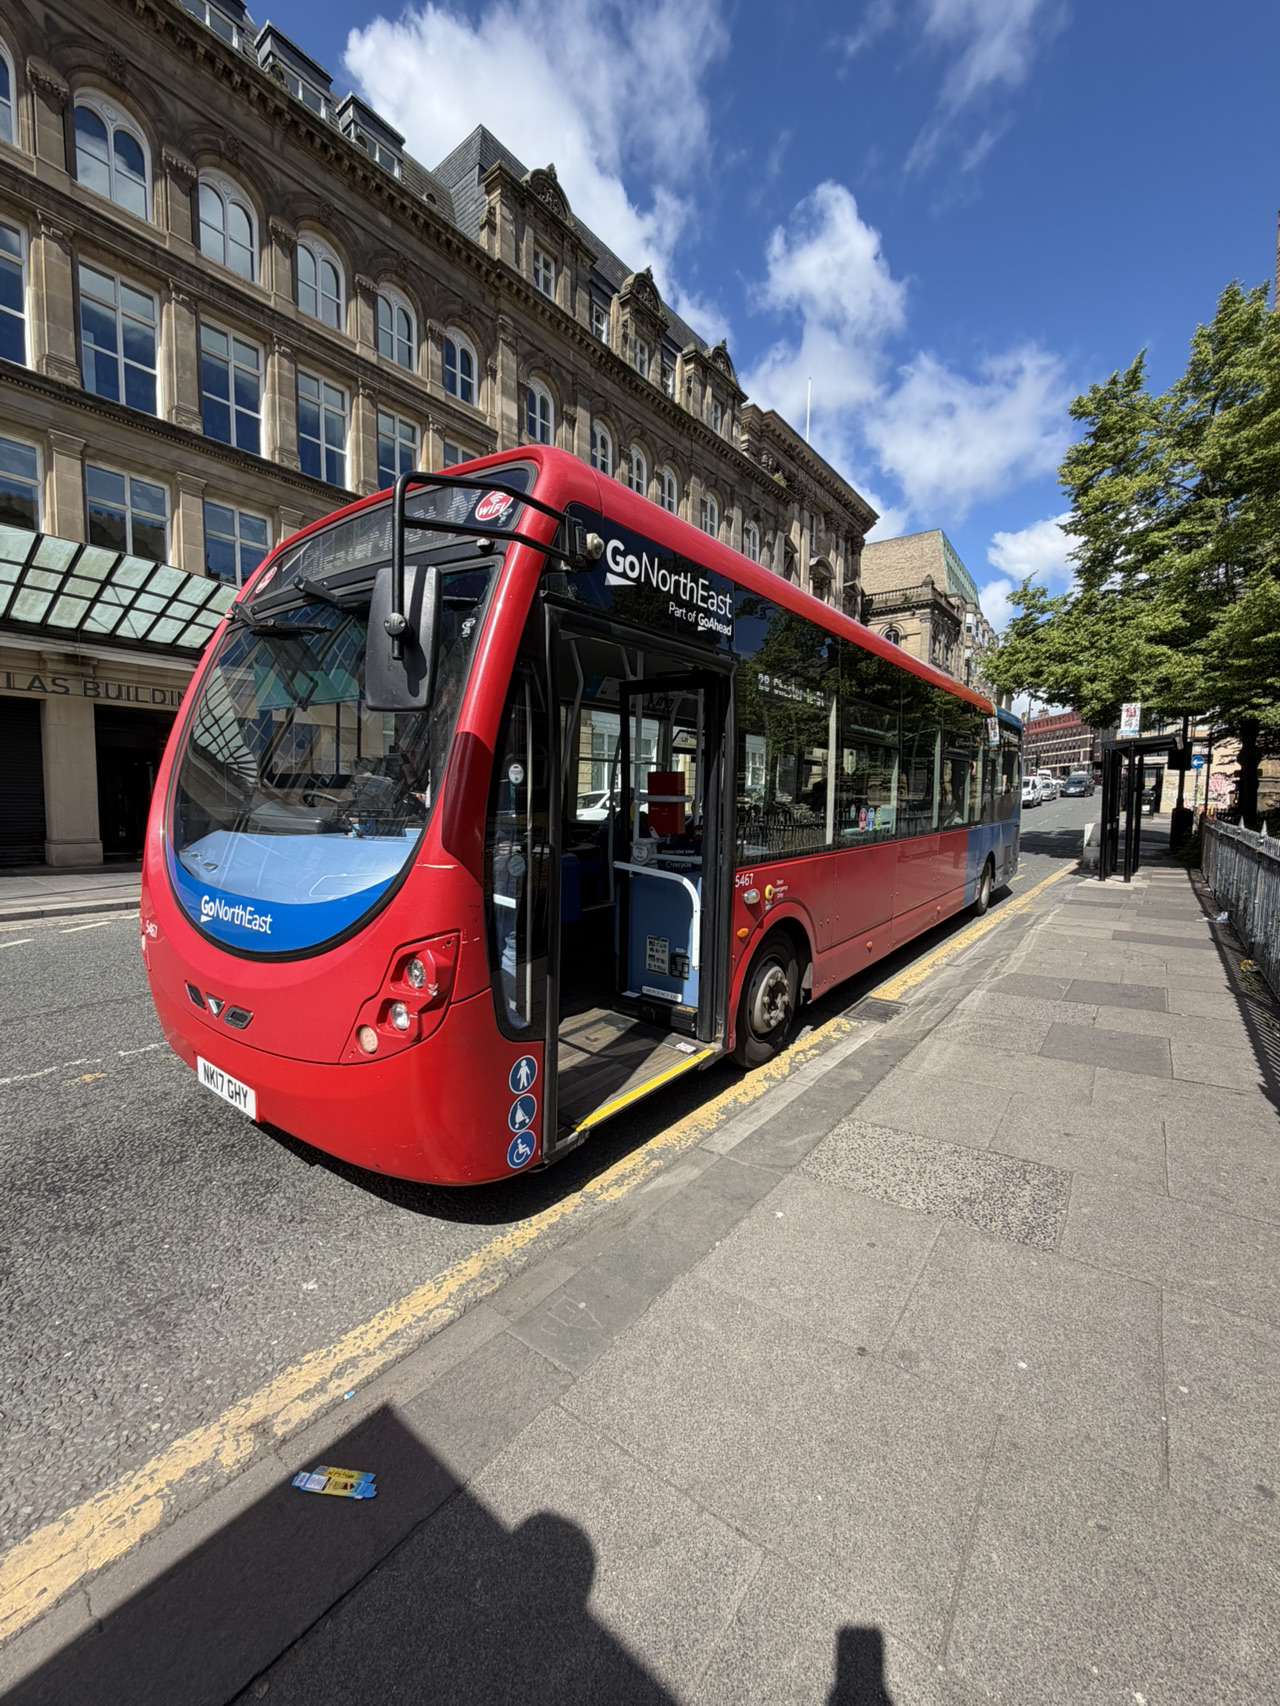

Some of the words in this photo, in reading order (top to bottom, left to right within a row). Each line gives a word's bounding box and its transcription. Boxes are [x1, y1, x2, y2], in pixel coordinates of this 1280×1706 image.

[606, 539, 733, 618] GoNorthEast
[668, 601, 687, 620] Part
[687, 611, 697, 623] of
[698, 613, 732, 636] GoAhead
[735, 873, 754, 888] 5467
[201, 895, 273, 934] GoNorthEast
[203, 1062, 225, 1093] NK17
[227, 1078, 249, 1109] GHY
